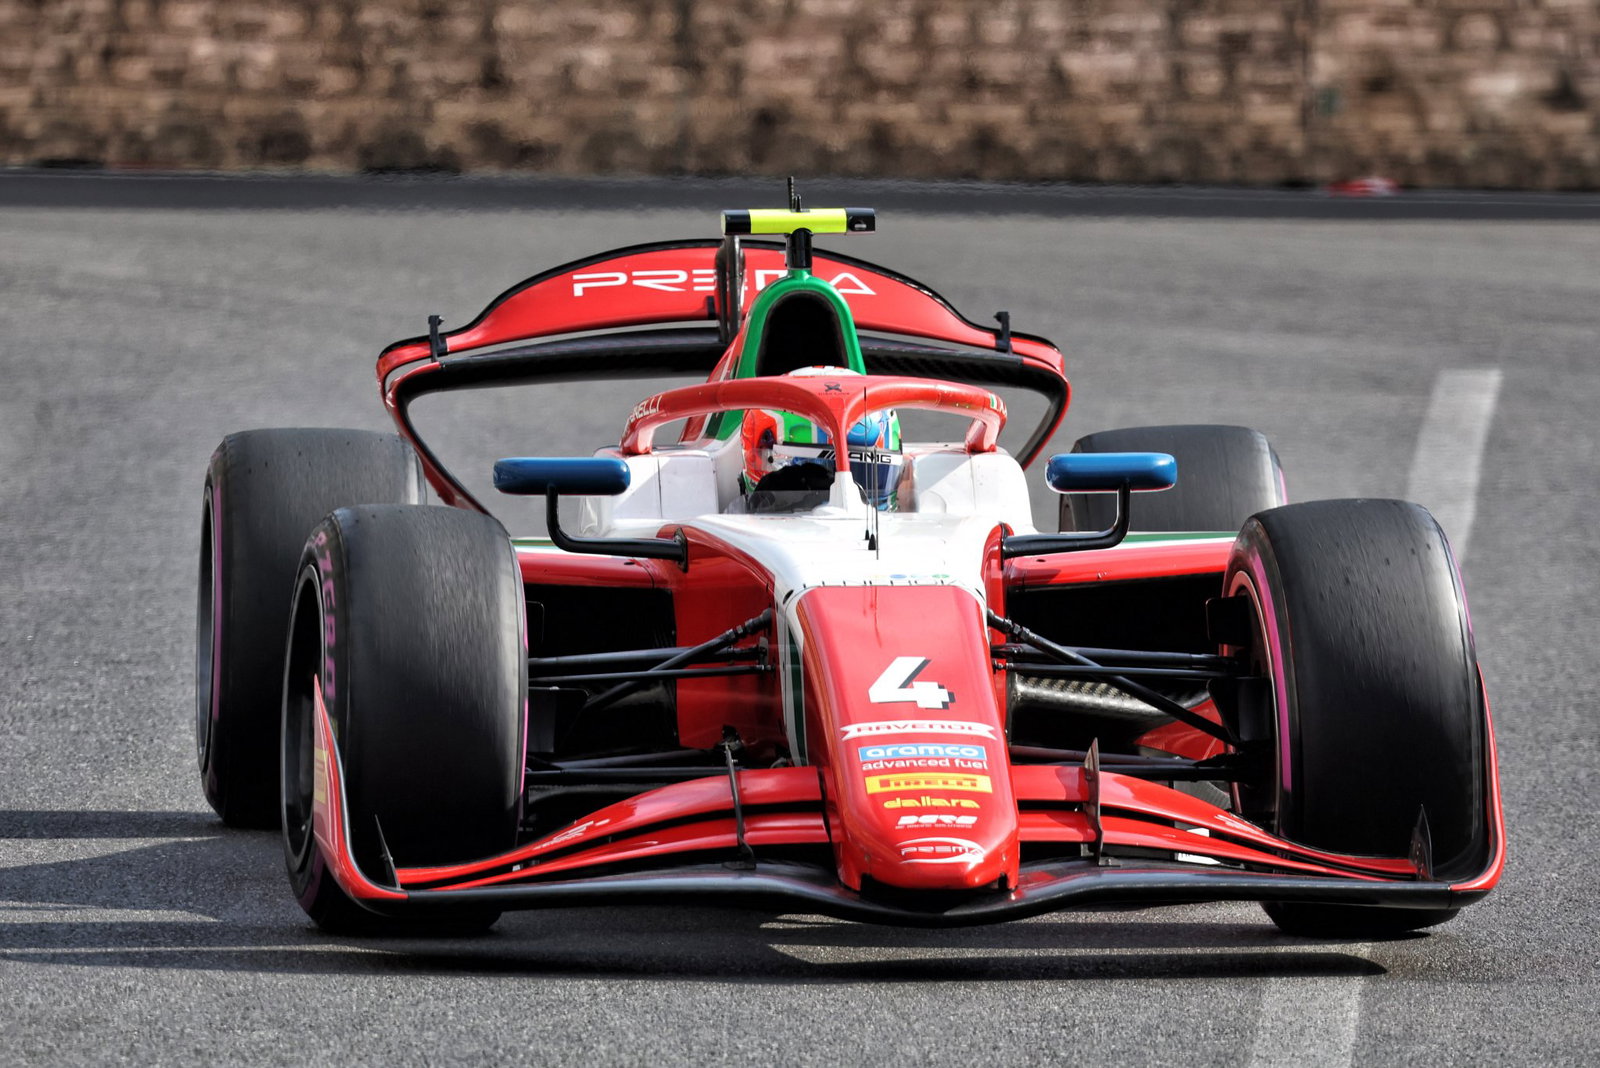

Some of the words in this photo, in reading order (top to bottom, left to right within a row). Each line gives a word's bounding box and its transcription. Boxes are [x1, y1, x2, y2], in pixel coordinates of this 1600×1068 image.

[317, 551, 336, 697] ZERO
[868, 656, 955, 709] 4
[857, 722, 982, 733] RAVENOL
[866, 745, 979, 758] aramco
[862, 758, 950, 771] advanced
[954, 758, 988, 770] fuel
[879, 777, 978, 789] PIRELLI
[883, 796, 981, 809] dallara
